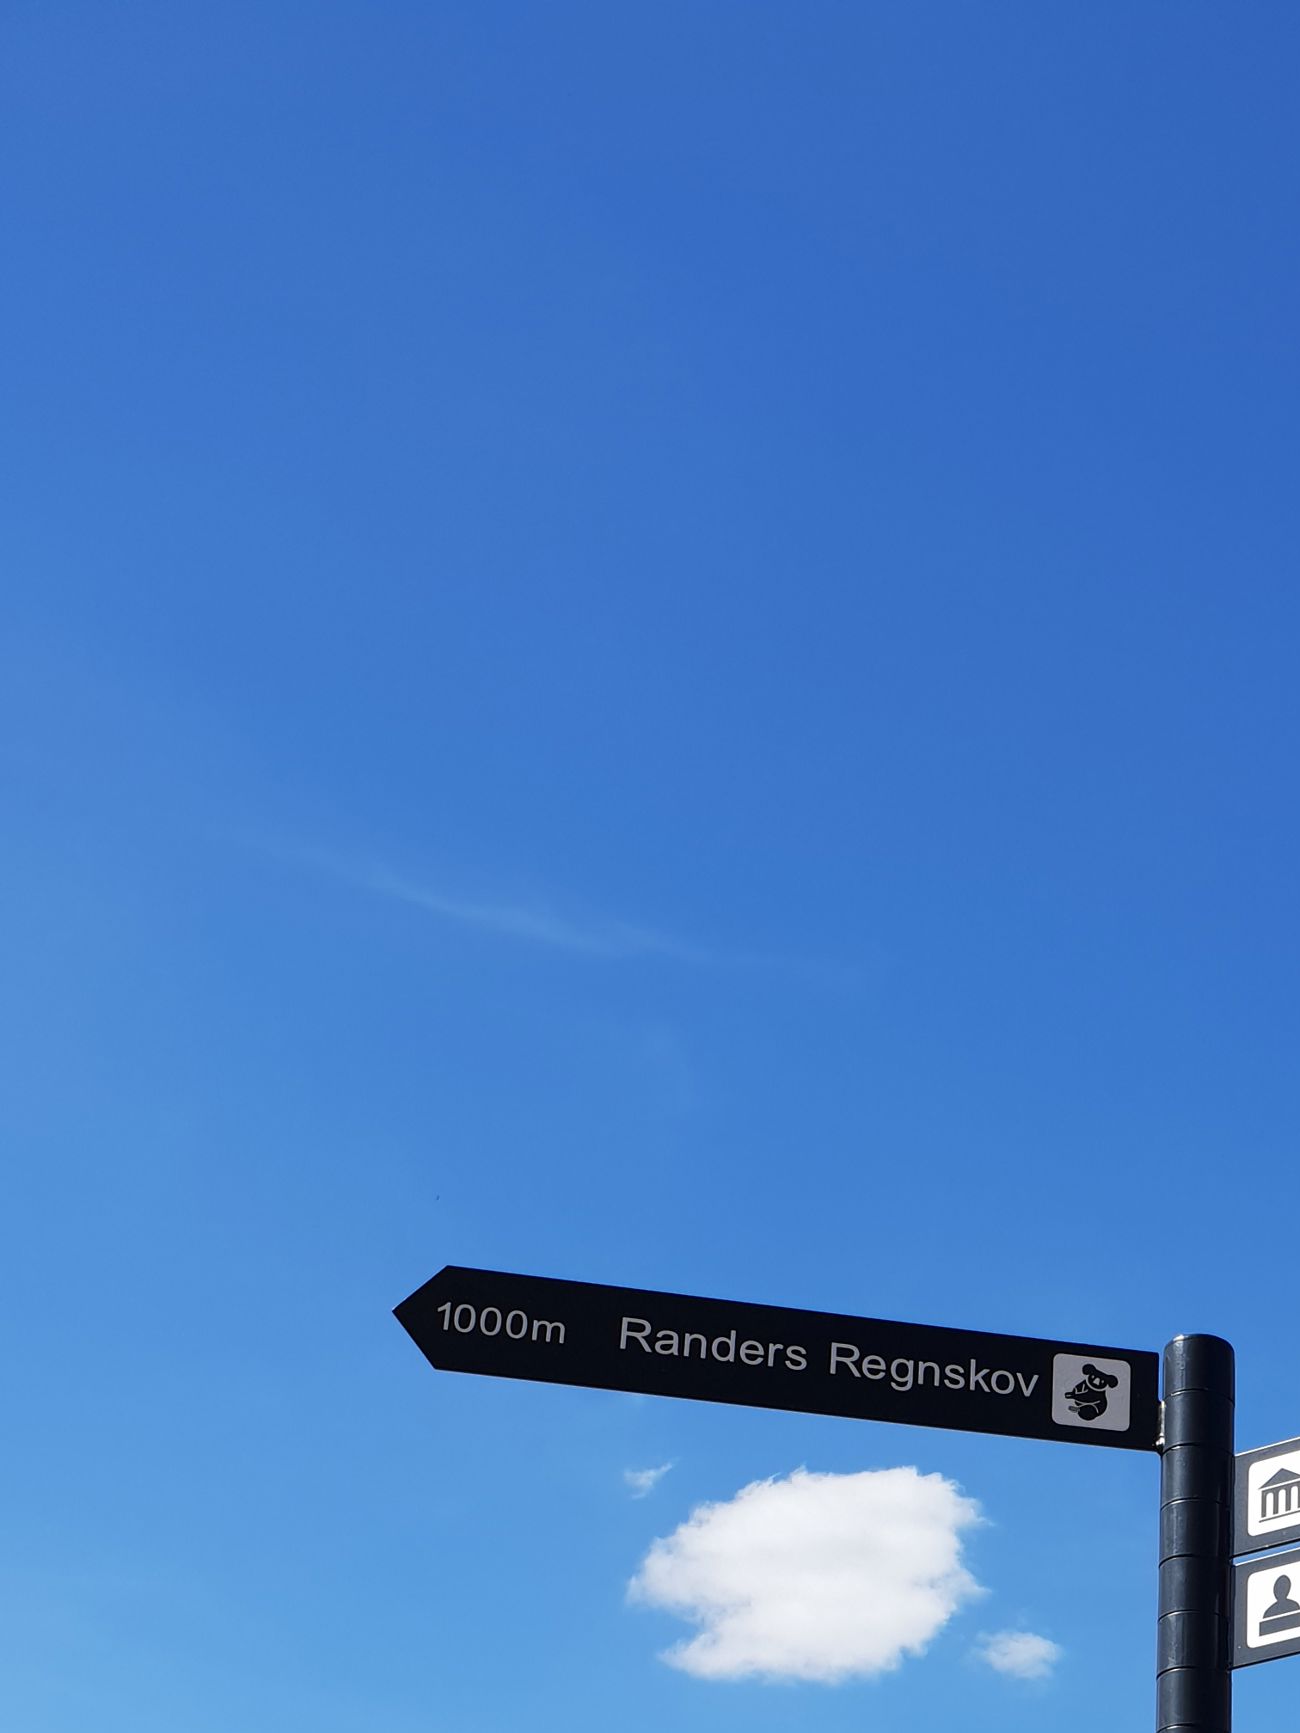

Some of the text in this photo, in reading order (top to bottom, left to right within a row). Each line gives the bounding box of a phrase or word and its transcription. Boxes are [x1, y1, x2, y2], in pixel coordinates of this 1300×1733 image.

[437, 1302, 1040, 1397] 1000m Randers Regnskov
